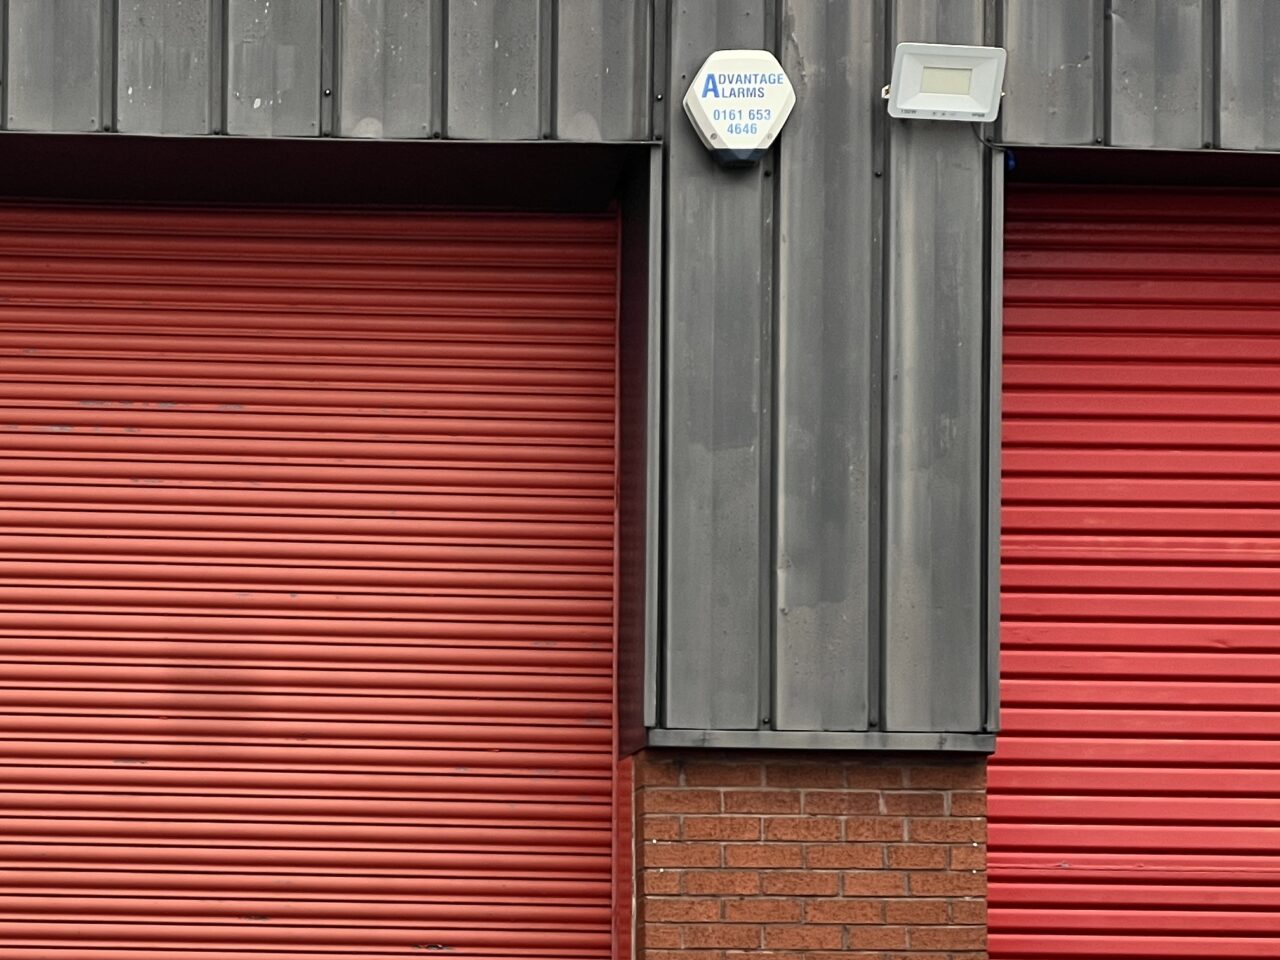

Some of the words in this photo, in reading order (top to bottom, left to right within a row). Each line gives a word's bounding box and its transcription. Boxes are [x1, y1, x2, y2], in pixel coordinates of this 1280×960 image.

[702, 73, 784, 98] ADVANTAGE
[713, 109, 743, 121] 0161
[748, 109, 771, 121] 653
[727, 123, 757, 134] 4646
